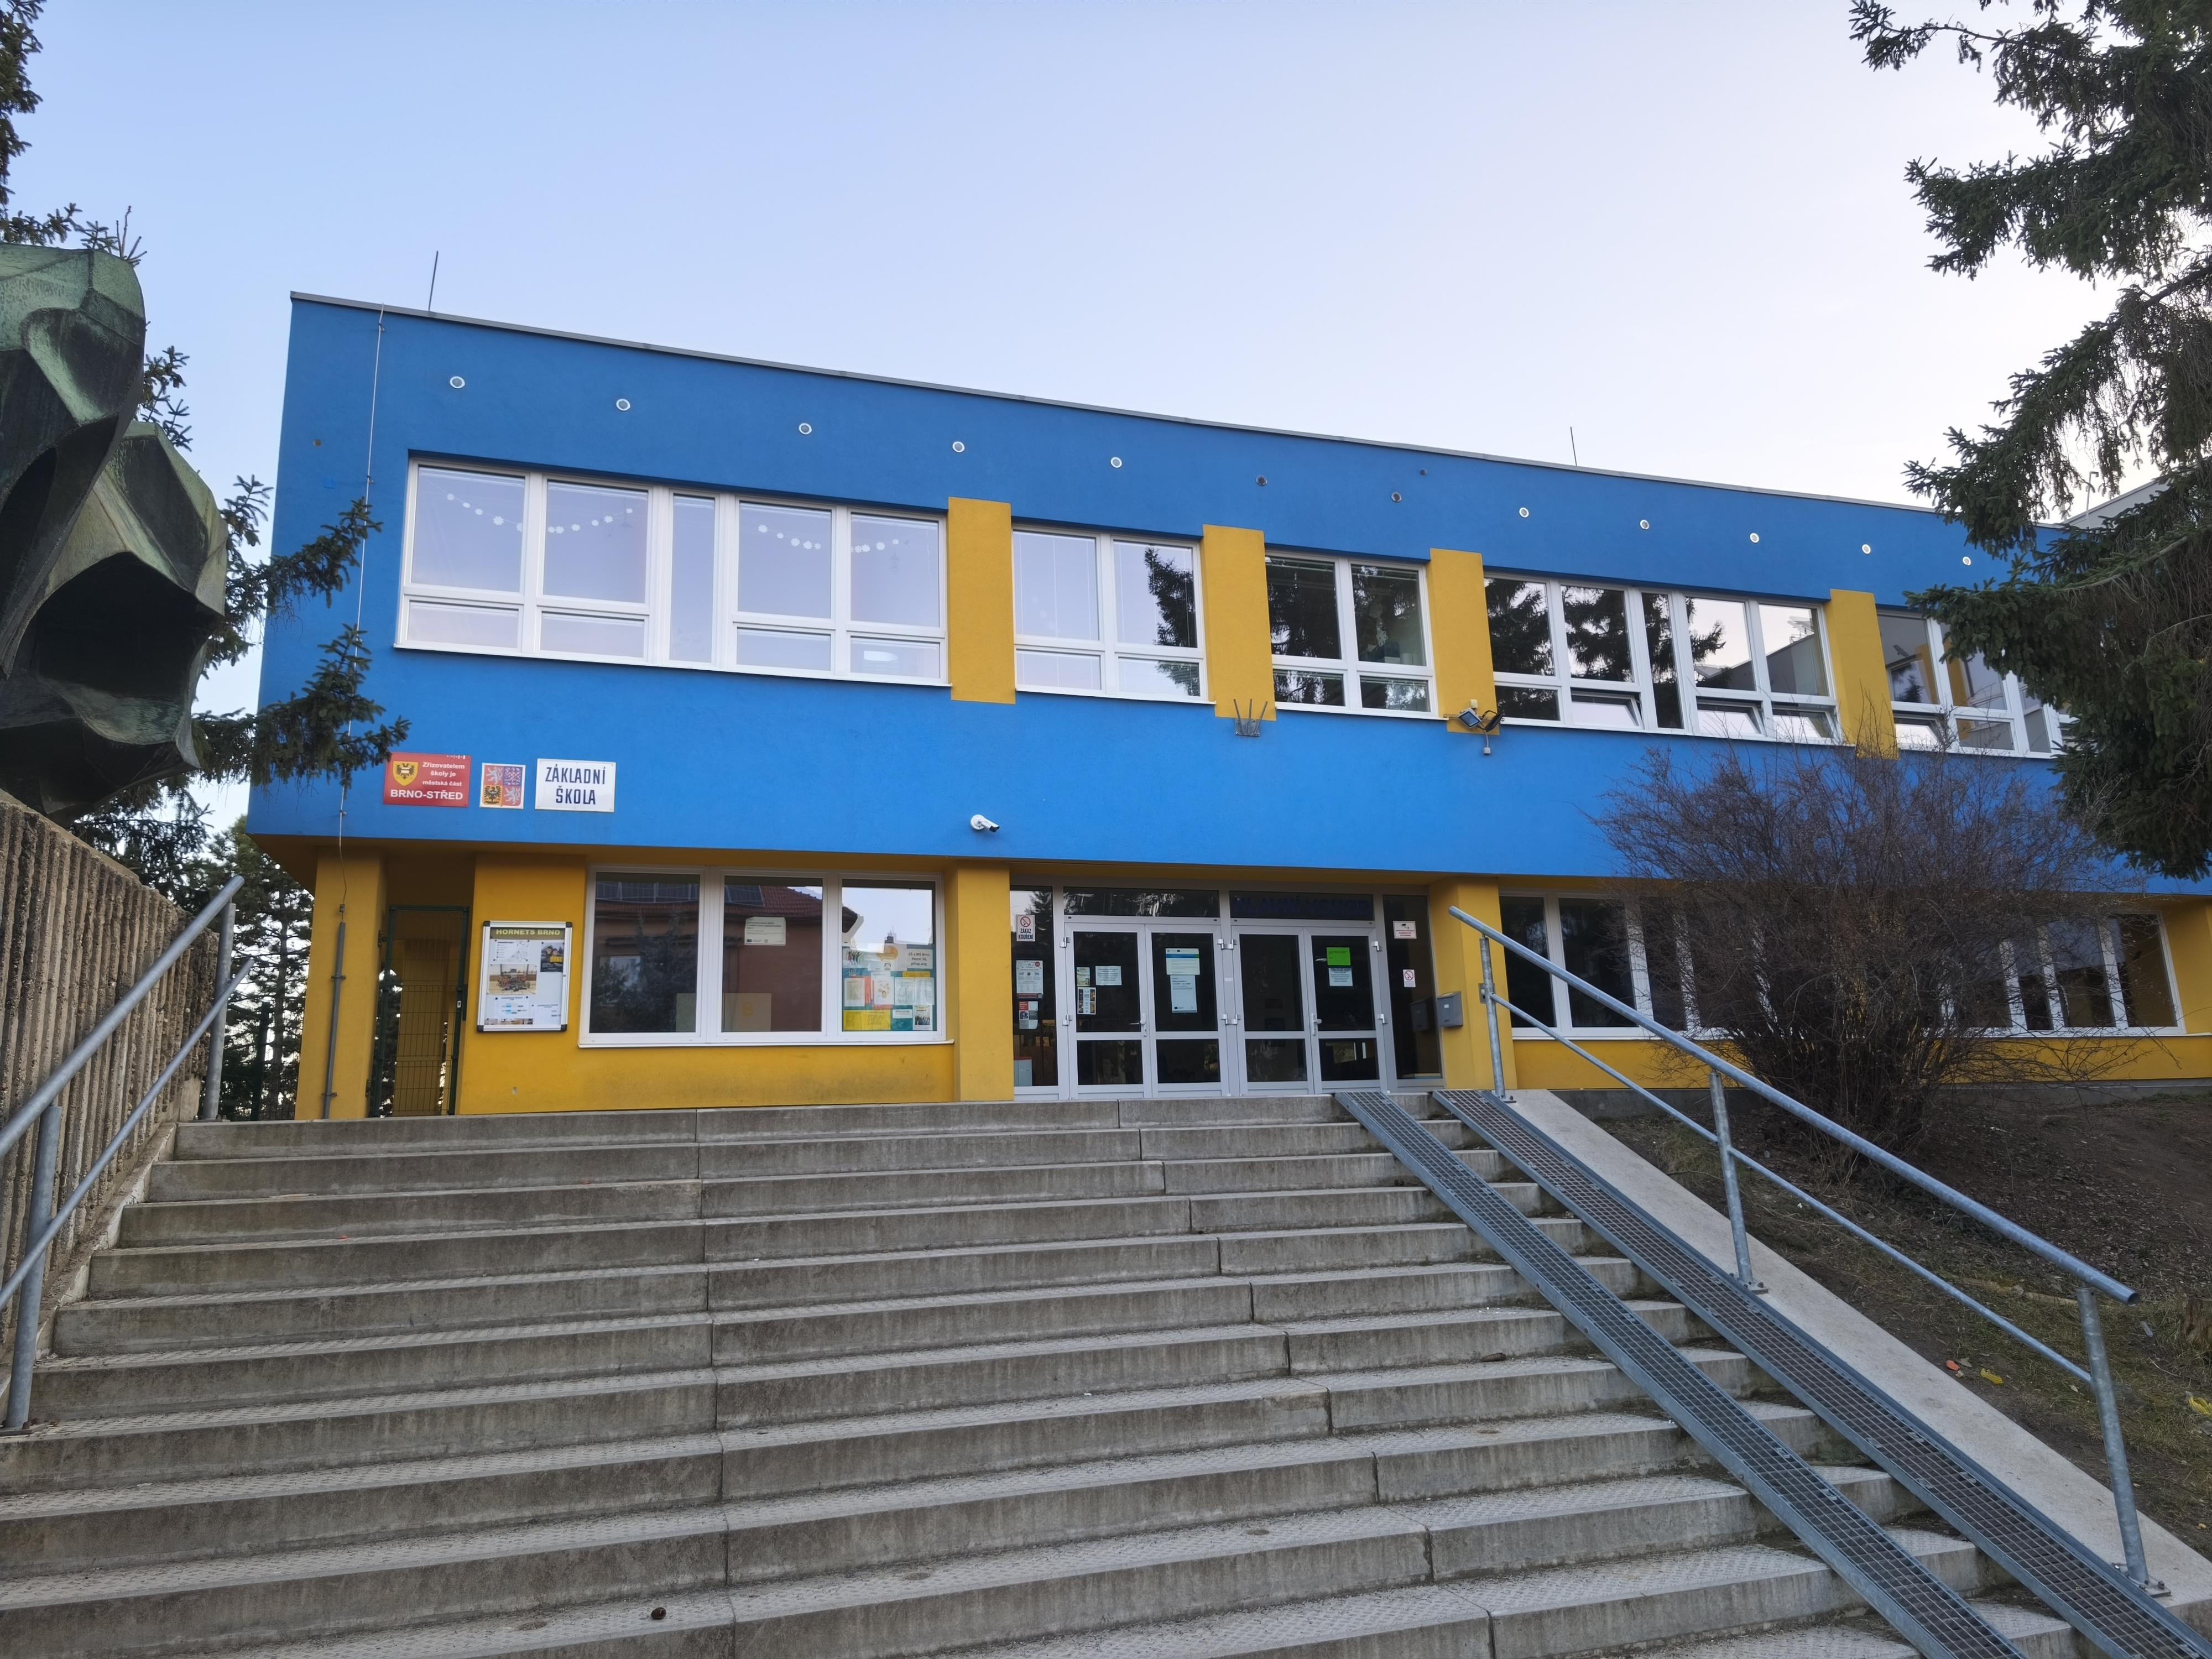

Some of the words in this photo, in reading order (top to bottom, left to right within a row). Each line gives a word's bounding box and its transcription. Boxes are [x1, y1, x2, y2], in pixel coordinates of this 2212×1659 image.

[545, 764, 606, 785] ZÁKLADNÍ
[390, 789, 463, 800] BRNO-STŘED
[556, 785, 596, 805] ŠKOLA
